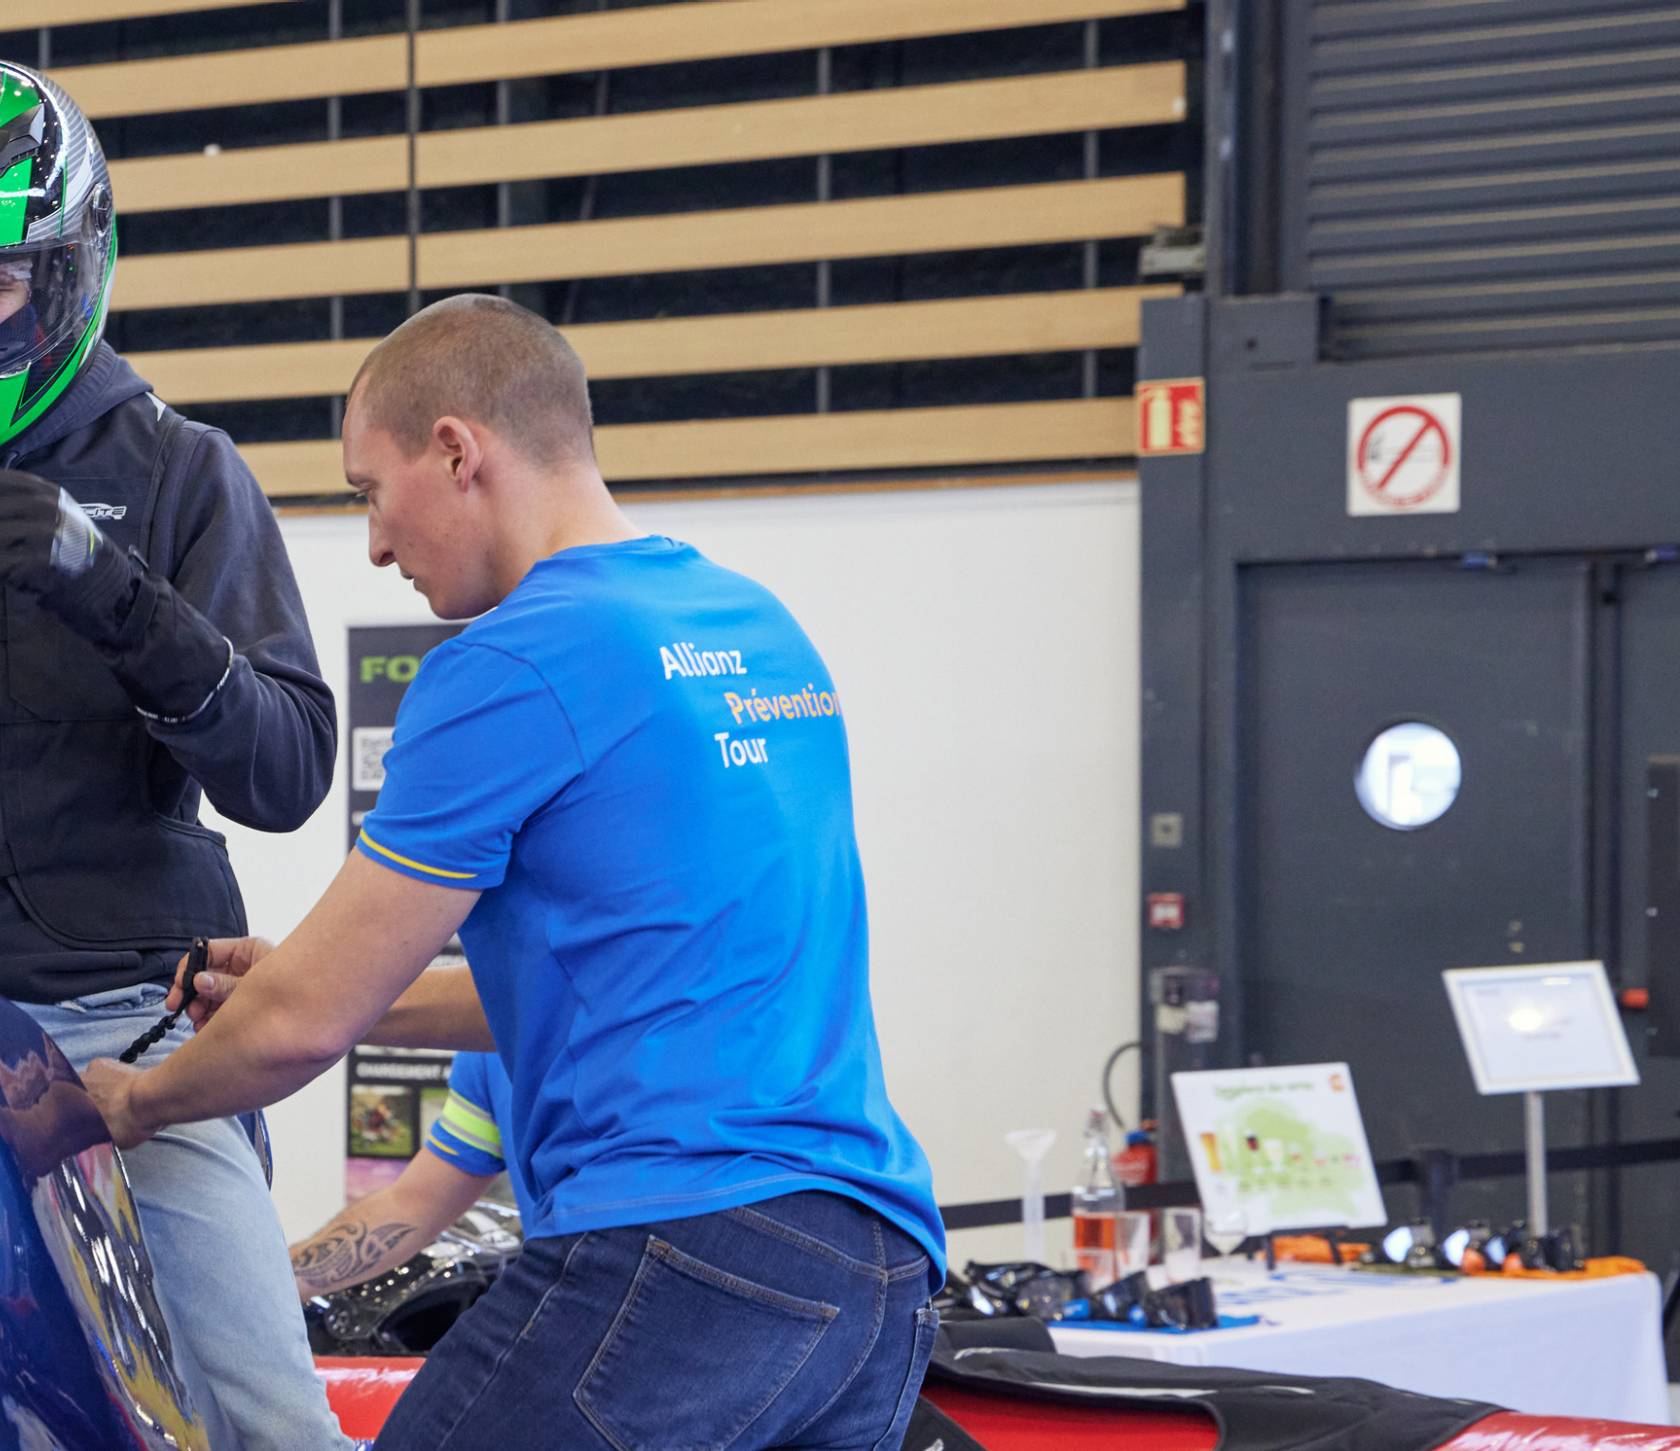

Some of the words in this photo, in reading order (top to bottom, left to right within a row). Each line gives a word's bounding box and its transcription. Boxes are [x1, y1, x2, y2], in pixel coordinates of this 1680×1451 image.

[359, 656, 420, 683] FO
[659, 641, 748, 681] Allianz
[713, 731, 769, 769] Tour
